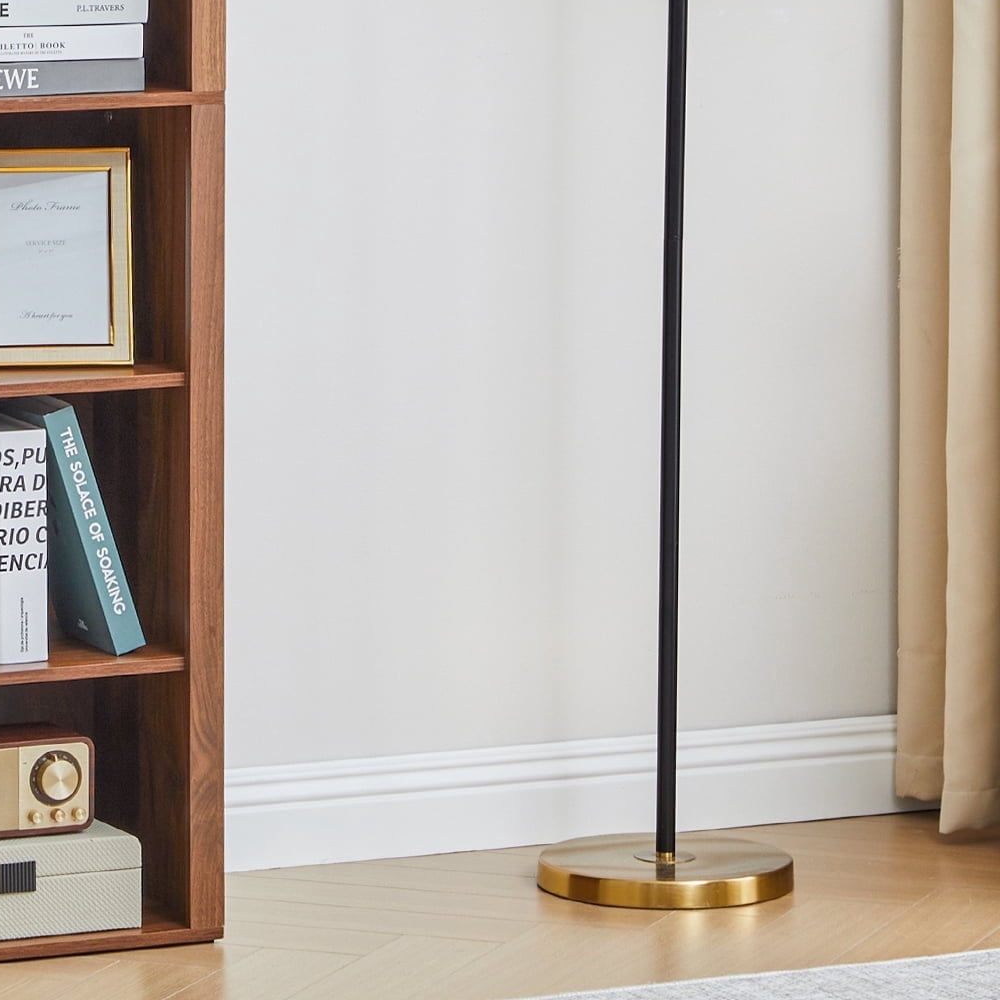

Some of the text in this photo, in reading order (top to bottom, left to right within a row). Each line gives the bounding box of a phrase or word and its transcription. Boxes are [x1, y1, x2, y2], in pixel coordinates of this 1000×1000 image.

[40, 41, 66, 49] BOOK
[9, 199, 42, 211] Photo
[60, 427, 126, 616] THE SOLACE OF SOAKING
